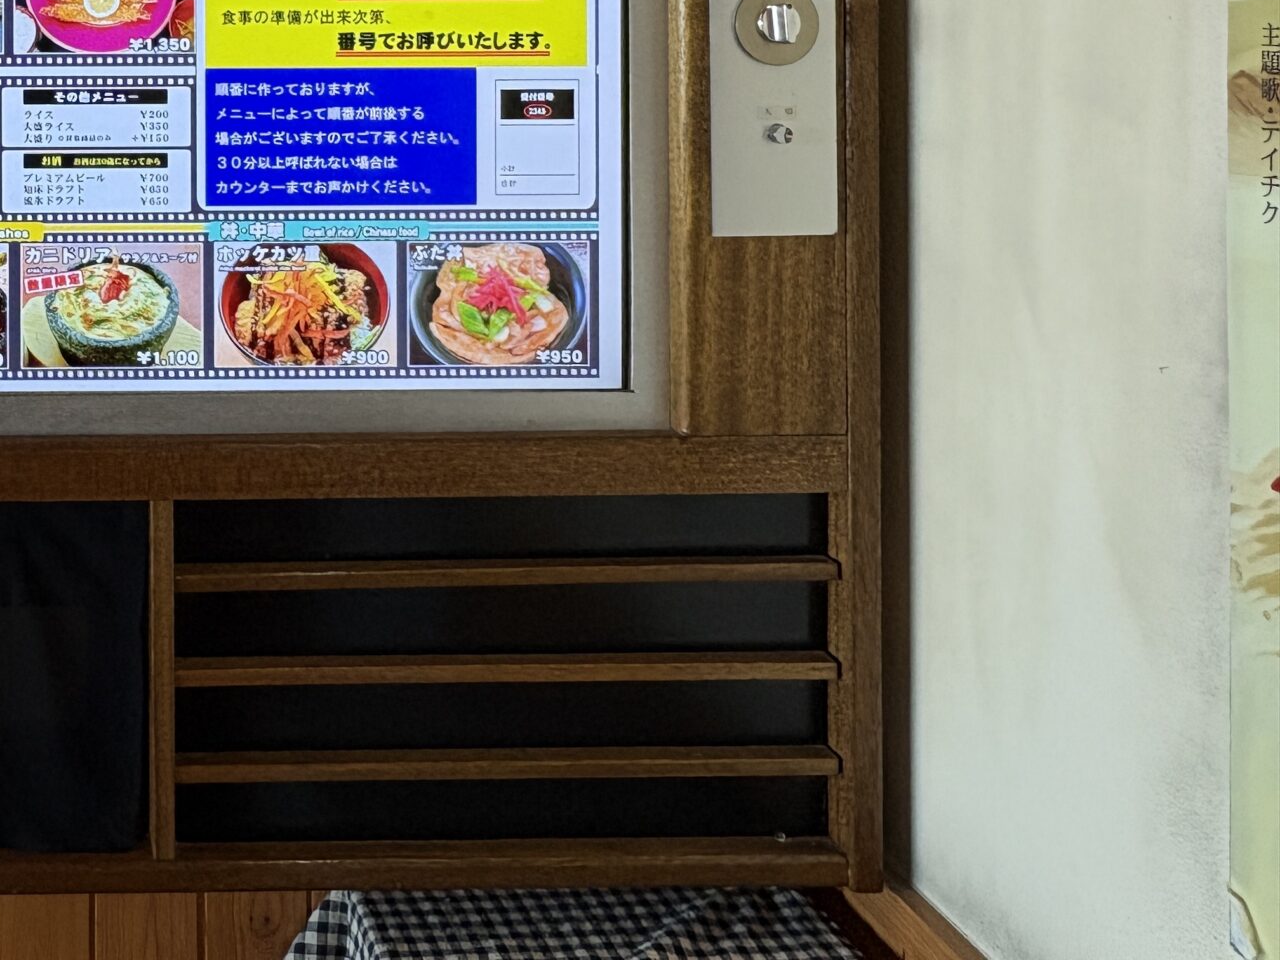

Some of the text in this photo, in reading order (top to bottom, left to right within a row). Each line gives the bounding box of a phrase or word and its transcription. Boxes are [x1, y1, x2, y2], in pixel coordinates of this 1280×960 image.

[221, 9, 392, 26] 食事の準備が出来次第、
[129, 38, 191, 52] ¥1,350
[337, 32, 552, 51] 番号でお呼びいたします。
[54, 91, 139, 103] その他メニュー
[215, 82, 375, 97] 順番に作っておりますが、
[24, 110, 54, 120] ライス
[215, 107, 425, 122] メニューによって順番が前後する
[215, 131, 461, 147] 場合がございますのでご了承ください。
[24, 174, 169, 183] プレミアムビール ¥700
[215, 180, 432, 195] カウンターまでお声かけください。
[303, 226, 325, 238] Bowl
[326, 226, 335, 237] of
[336, 227, 355, 238] rice
[363, 226, 397, 238] Chinese
[398, 226, 419, 238] food
[26, 246, 112, 264] カニドリア
[412, 244, 464, 261] ぶた丼
[27, 274, 81, 292] 数量限定
[136, 350, 199, 366] ¥1,100
[341, 350, 390, 364] ¥900
[535, 350, 583, 364] ¥950
